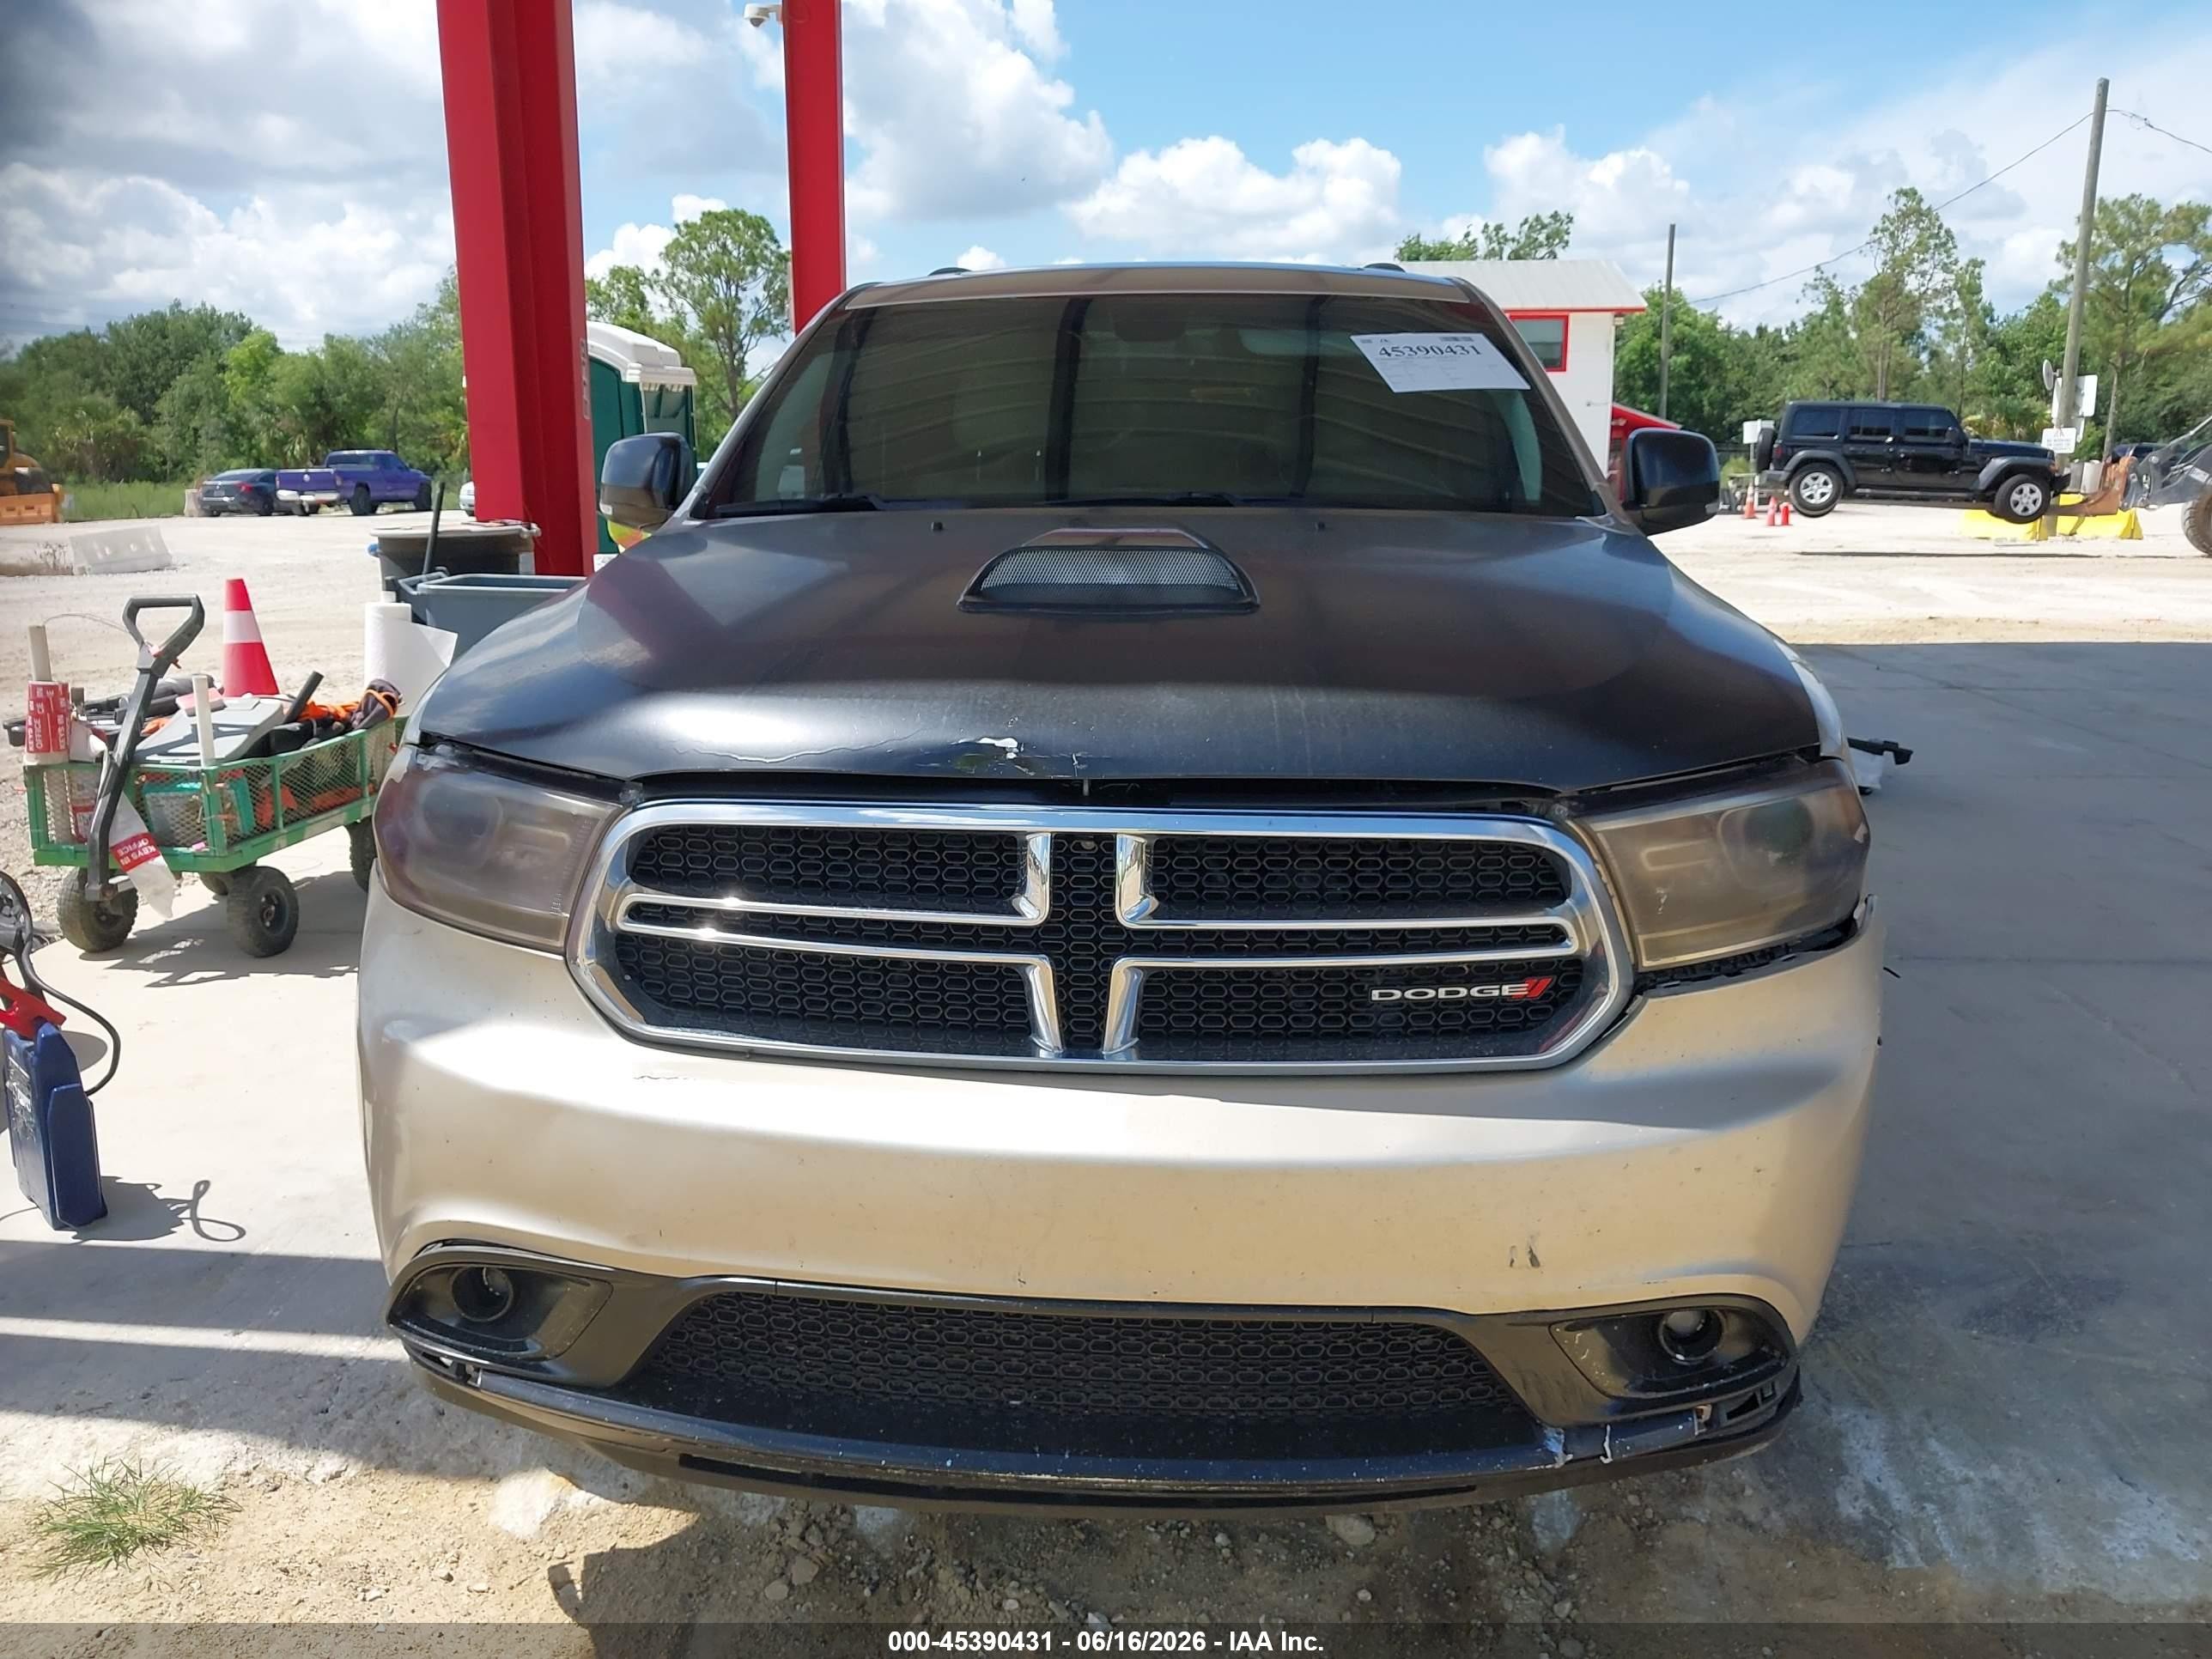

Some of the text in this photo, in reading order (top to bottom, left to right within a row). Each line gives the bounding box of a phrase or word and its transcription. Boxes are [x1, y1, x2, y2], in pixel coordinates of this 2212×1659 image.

[1378, 344, 1483, 357] 45390431
[117, 838, 149, 856] OFFICE
[1370, 982, 1529, 1001] DODGE
